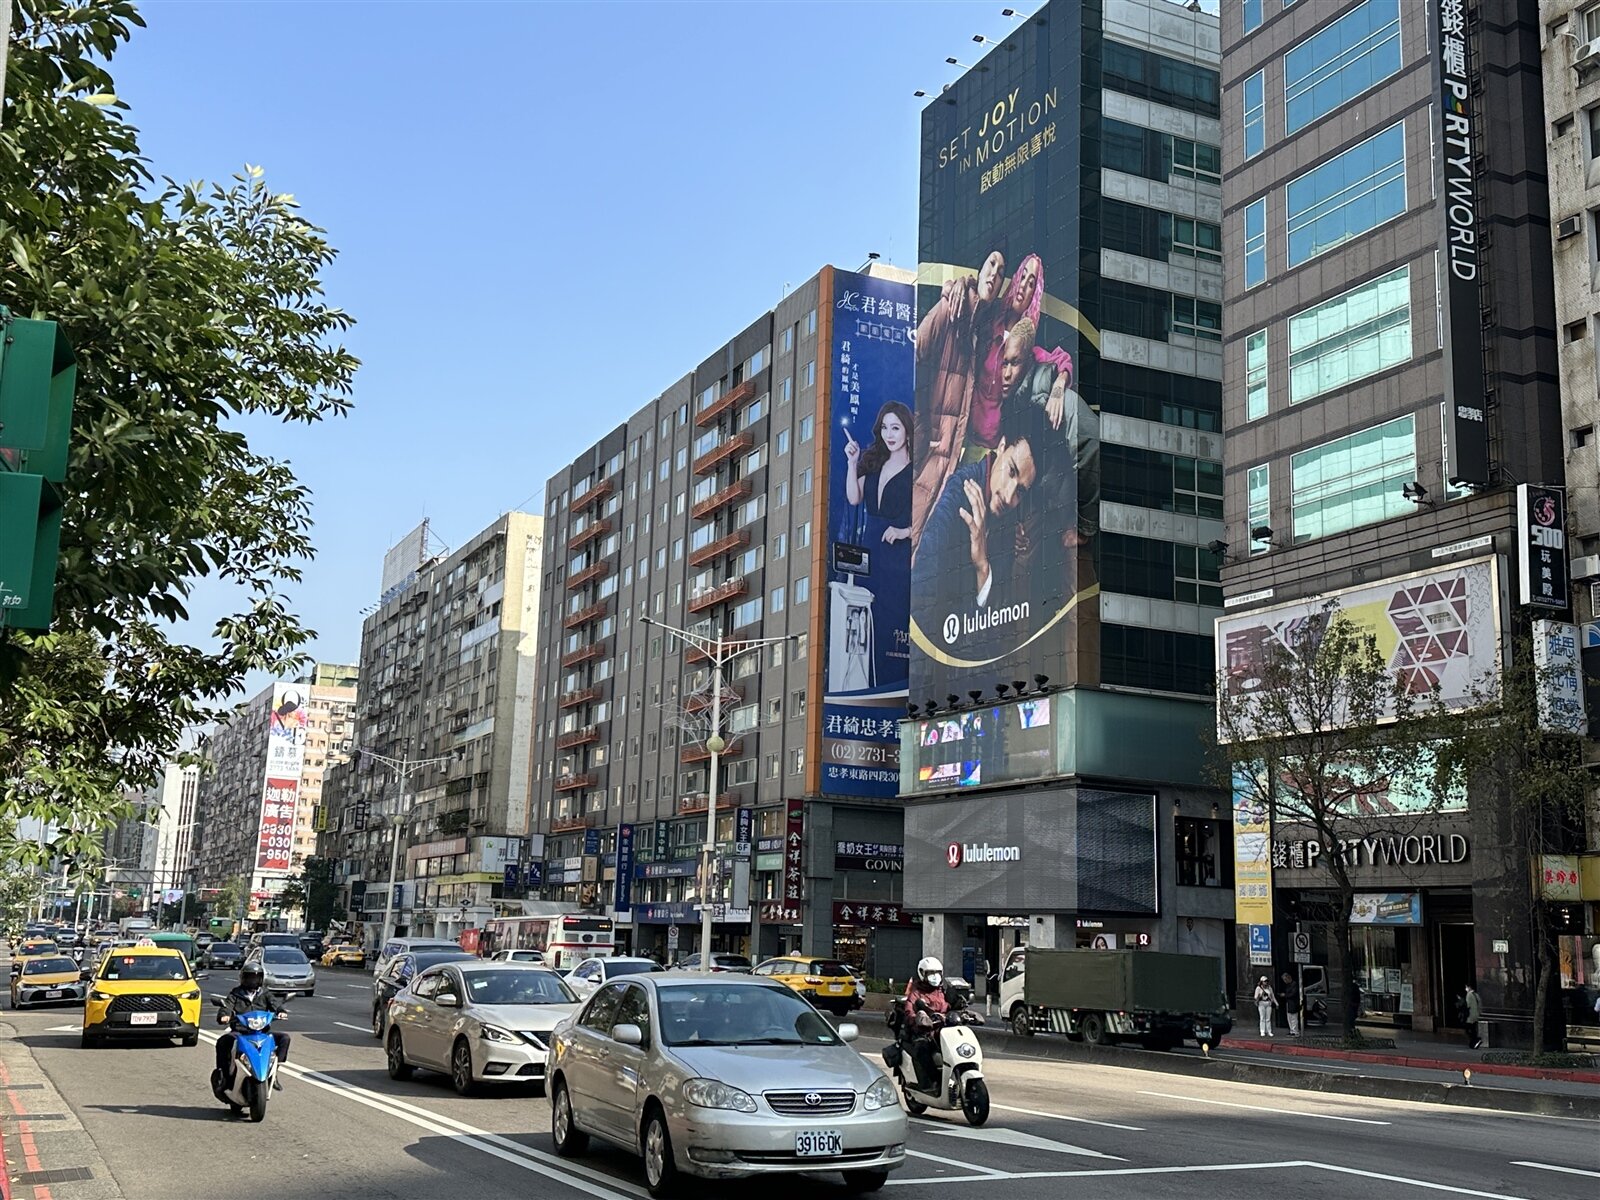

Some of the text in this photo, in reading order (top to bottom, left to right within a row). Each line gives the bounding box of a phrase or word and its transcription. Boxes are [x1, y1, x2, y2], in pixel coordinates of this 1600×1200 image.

[938, 87, 1021, 170] SET JOY
[958, 86, 1058, 175] IN MOTION
[979, 121, 1058, 195] 啟動無限喜悅
[861, 295, 917, 323] 君綺醫
[1457, 405, 1483, 423] 忠孝店
[1541, 549, 1553, 597] 玩美殿
[963, 601, 1030, 635] lululemon
[831, 742, 855, 761] (02)
[828, 766, 901, 782] 忠孝東路四段30
[266, 786, 296, 804] 迦勒
[264, 803, 294, 819] 廣告
[260, 836, 290, 849] -030
[737, 843, 748, 851] 6F
[1307, 834, 1467, 867] PRTYWORLD
[259, 849, 289, 861] -950
[963, 843, 1020, 863] lululemon
[1272, 840, 1305, 868] 錢櫃
[787, 831, 801, 900] 全祥茶莊
[865, 859, 902, 871] GOVIN
[840, 903, 899, 922] 全祥茶莊
[1253, 927, 1260, 941] P
[797, 1135, 842, 1152] 3916-DK
